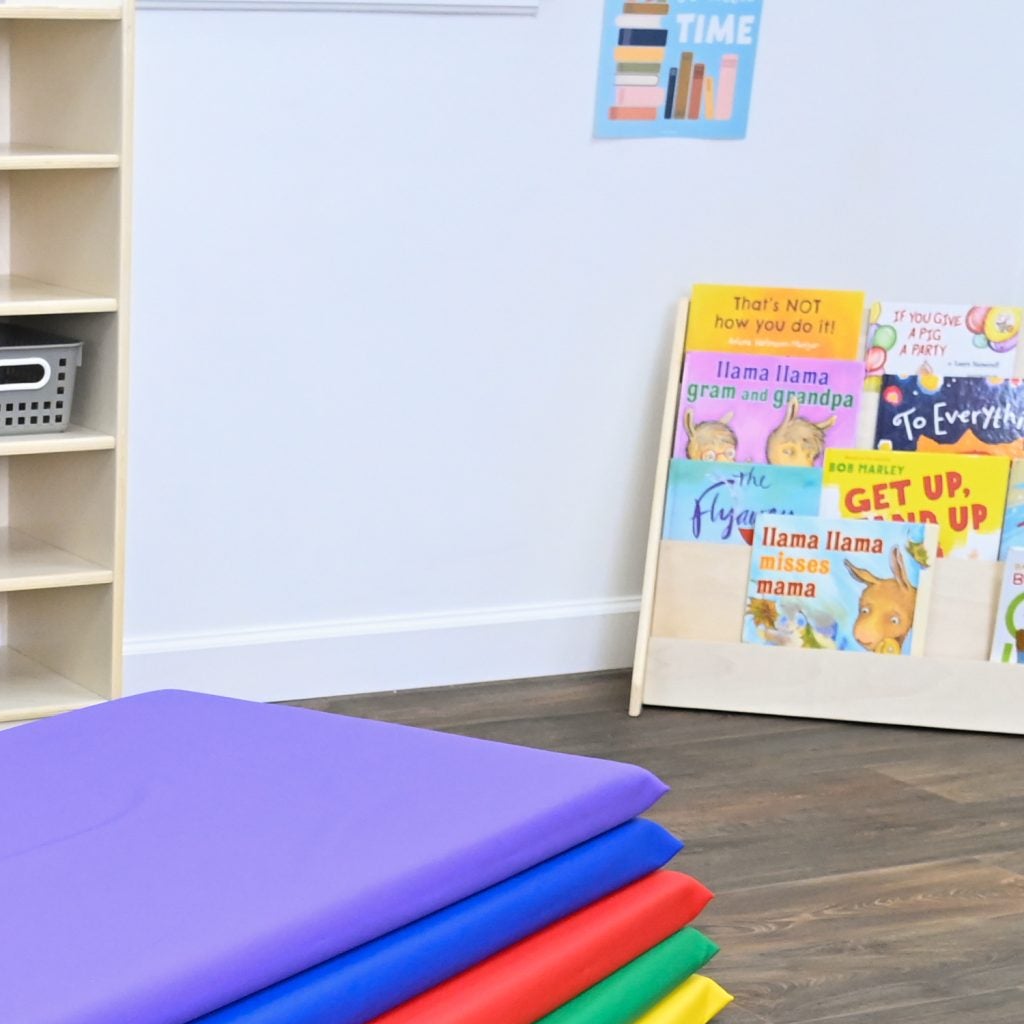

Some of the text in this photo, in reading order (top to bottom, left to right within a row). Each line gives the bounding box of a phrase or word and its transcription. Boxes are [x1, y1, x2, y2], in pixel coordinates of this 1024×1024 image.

[676, 13, 755, 45] TIME
[734, 296, 821, 314] That's NOT
[714, 314, 836, 335] how you do it!
[894, 310, 963, 327] IF YOU GIVE
[908, 328, 941, 341] A PIG
[899, 343, 948, 357] A PARTY
[717, 361, 829, 385] llama llama
[687, 383, 854, 411] gram and grandpa
[892, 407, 927, 441] To
[829, 462, 904, 475] BOB MARLEY
[844, 471, 970, 514] GET UP,
[762, 526, 884, 554] llama llama
[759, 551, 831, 575] misses
[757, 580, 817, 598] mama
